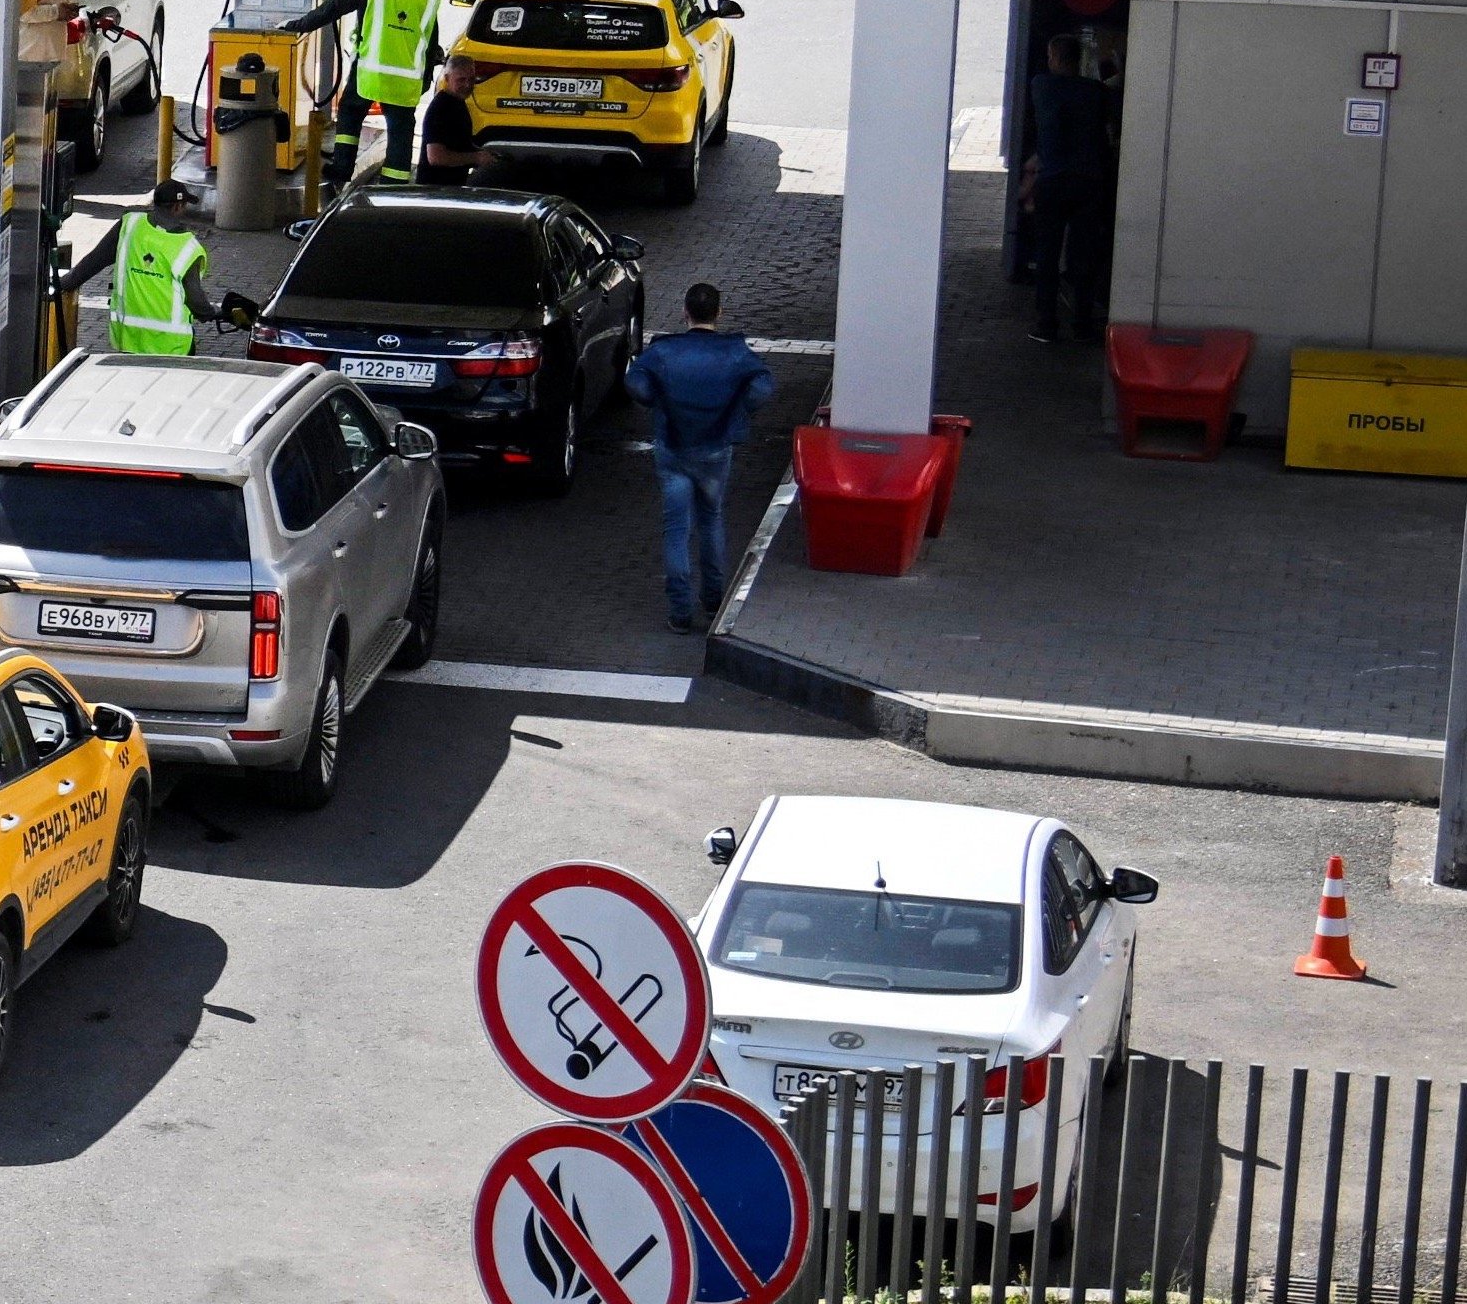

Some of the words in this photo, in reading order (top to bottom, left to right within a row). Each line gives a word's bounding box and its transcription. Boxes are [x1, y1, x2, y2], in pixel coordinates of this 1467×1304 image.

[587, 27, 619, 36] Аренда
[1372, 58, 1389, 70] ПГ
[526, 79, 576, 93] У539ВВ
[578, 80, 598, 90] 797
[502, 99, 552, 108] ТАКСОПАРК
[344, 361, 405, 379] Р122РВ
[408, 364, 432, 377] 777
[1347, 413, 1425, 433] ПРОБЫ
[47, 604, 117, 630] Е968ВУ
[120, 611, 149, 627] 977
[22, 808, 72, 861] АРЕНДА
[69, 786, 108, 837] ТАКСИ
